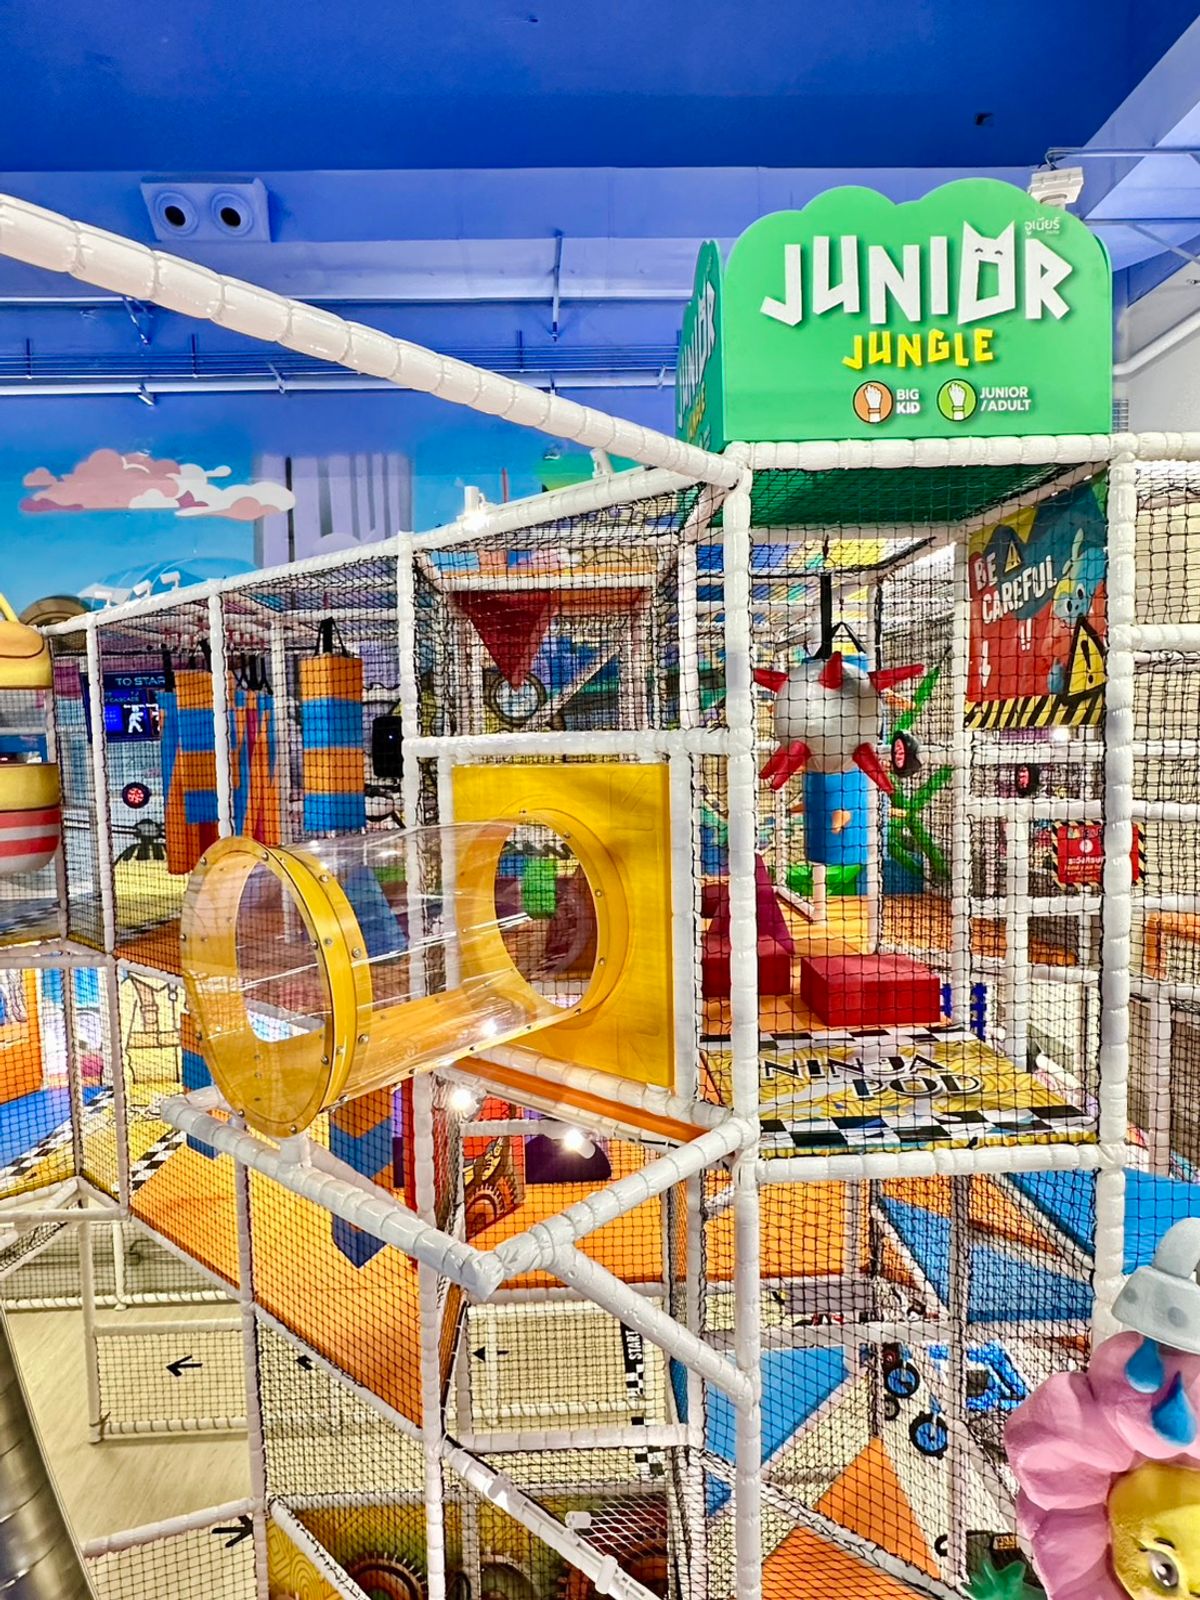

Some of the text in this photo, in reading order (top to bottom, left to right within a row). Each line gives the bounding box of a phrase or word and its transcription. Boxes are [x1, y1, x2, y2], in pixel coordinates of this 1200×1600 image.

[760, 220, 1073, 326] JUNIOR
[841, 328, 996, 369] JUNGLE
[896, 389, 919, 400] BIG
[979, 387, 1028, 398] JUNIOR
[980, 399, 1031, 411] /ADULT
[896, 402, 920, 414] KID
[974, 552, 998, 591] BE
[982, 555, 1058, 624] CAREFUL
[115, 675, 166, 686] TO STAR
[763, 1053, 946, 1080] NINJA
[852, 1073, 985, 1100] POD
[625, 1330, 643, 1361] START
